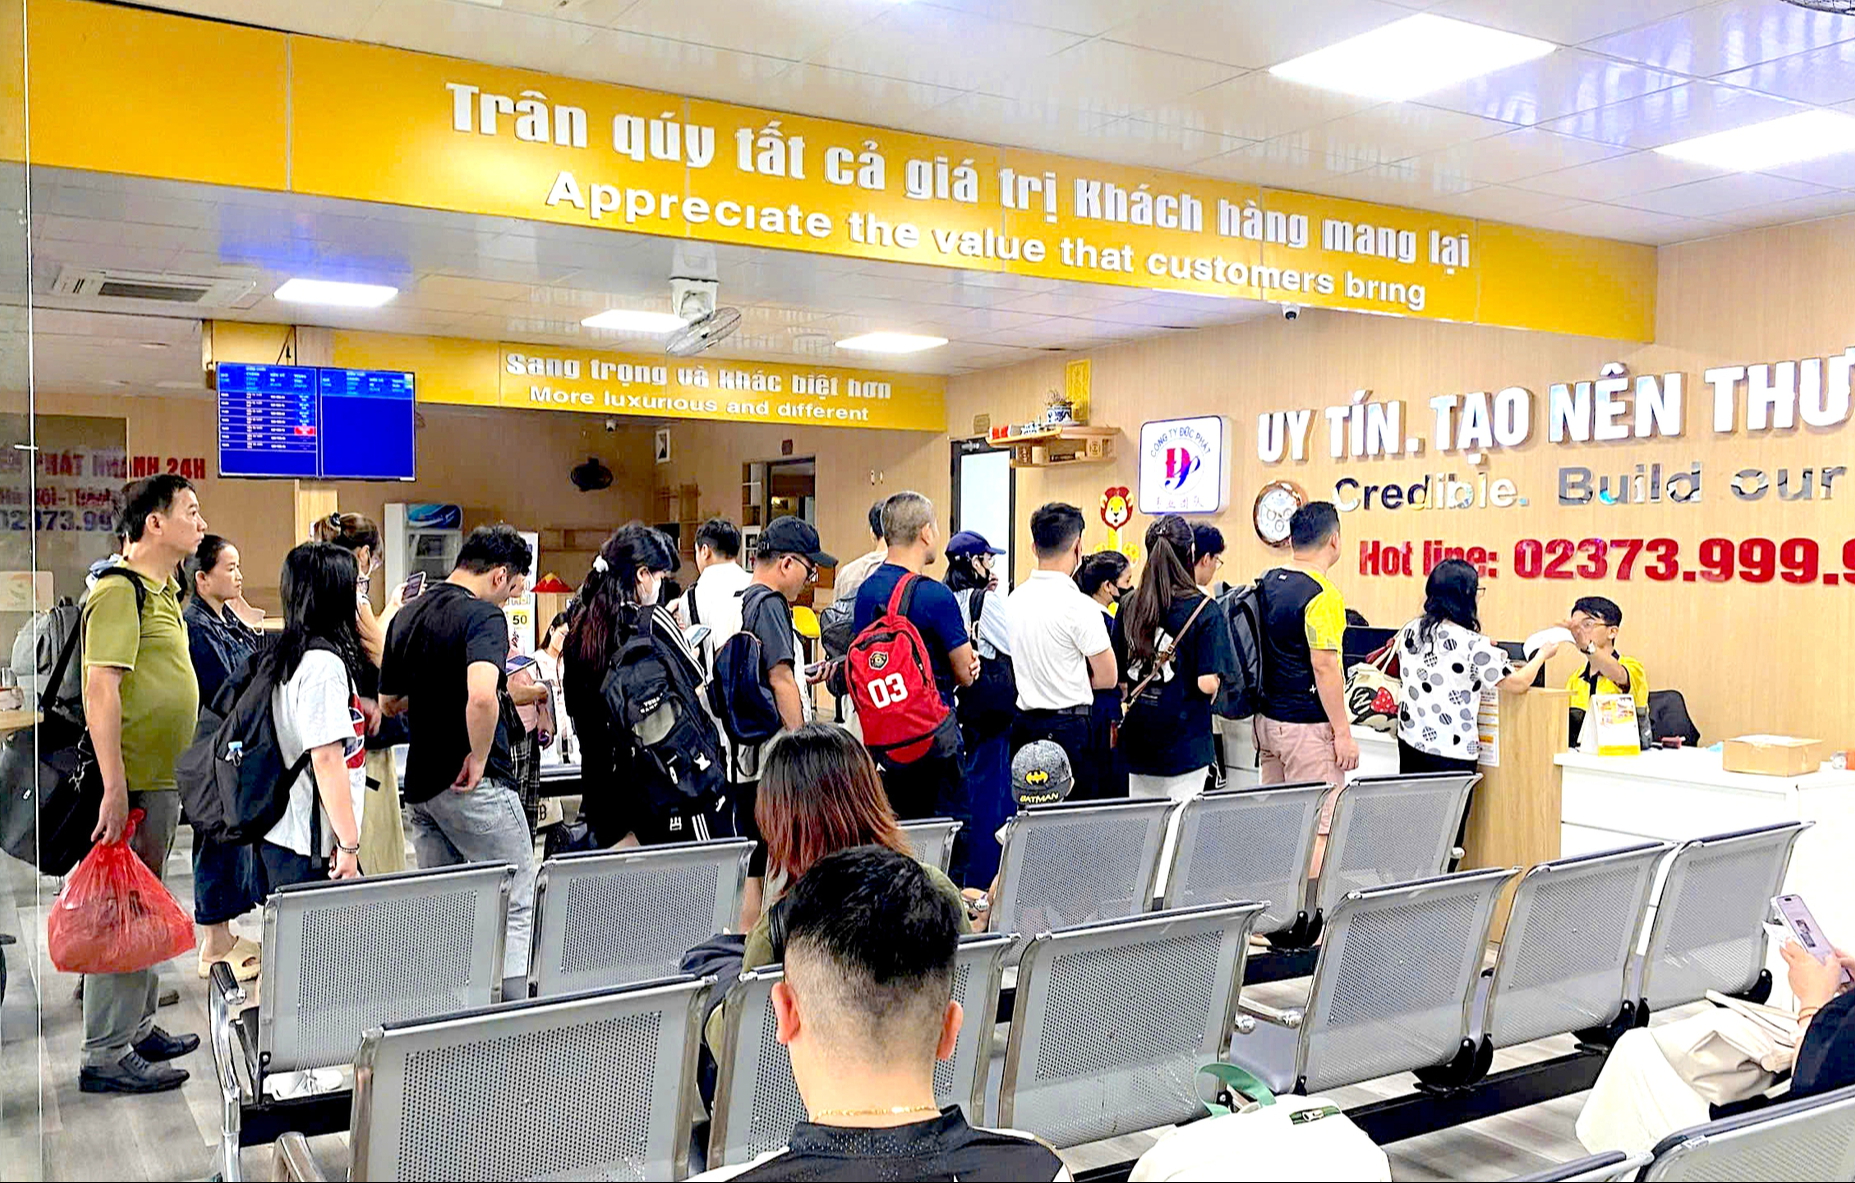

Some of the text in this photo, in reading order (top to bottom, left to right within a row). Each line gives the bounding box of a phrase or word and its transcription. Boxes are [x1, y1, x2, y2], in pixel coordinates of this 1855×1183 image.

[445, 82, 1470, 275] Trân qúy tất cả giá trị Khách hàng mang lại
[545, 170, 1427, 312] Appreciate the value that customers bring
[505, 352, 581, 380] Sang
[589, 358, 668, 387] trọng
[676, 365, 710, 388] và
[791, 373, 839, 400] biệt
[847, 377, 892, 400] hơn
[529, 385, 869, 422] More luxurious and different
[1257, 409, 1314, 464] UY
[1325, 389, 1424, 460] TÍN.
[1430, 386, 1533, 466] TẠO
[1548, 361, 1685, 444] NÊN
[166, 456, 206, 480] 24H
[1332, 460, 1848, 513] Credible. Build our
[1359, 540, 1413, 577] Hot
[512, 614, 528, 626] 50
[867, 672, 909, 709] 03
[1019, 791, 1059, 804] BATMAN
